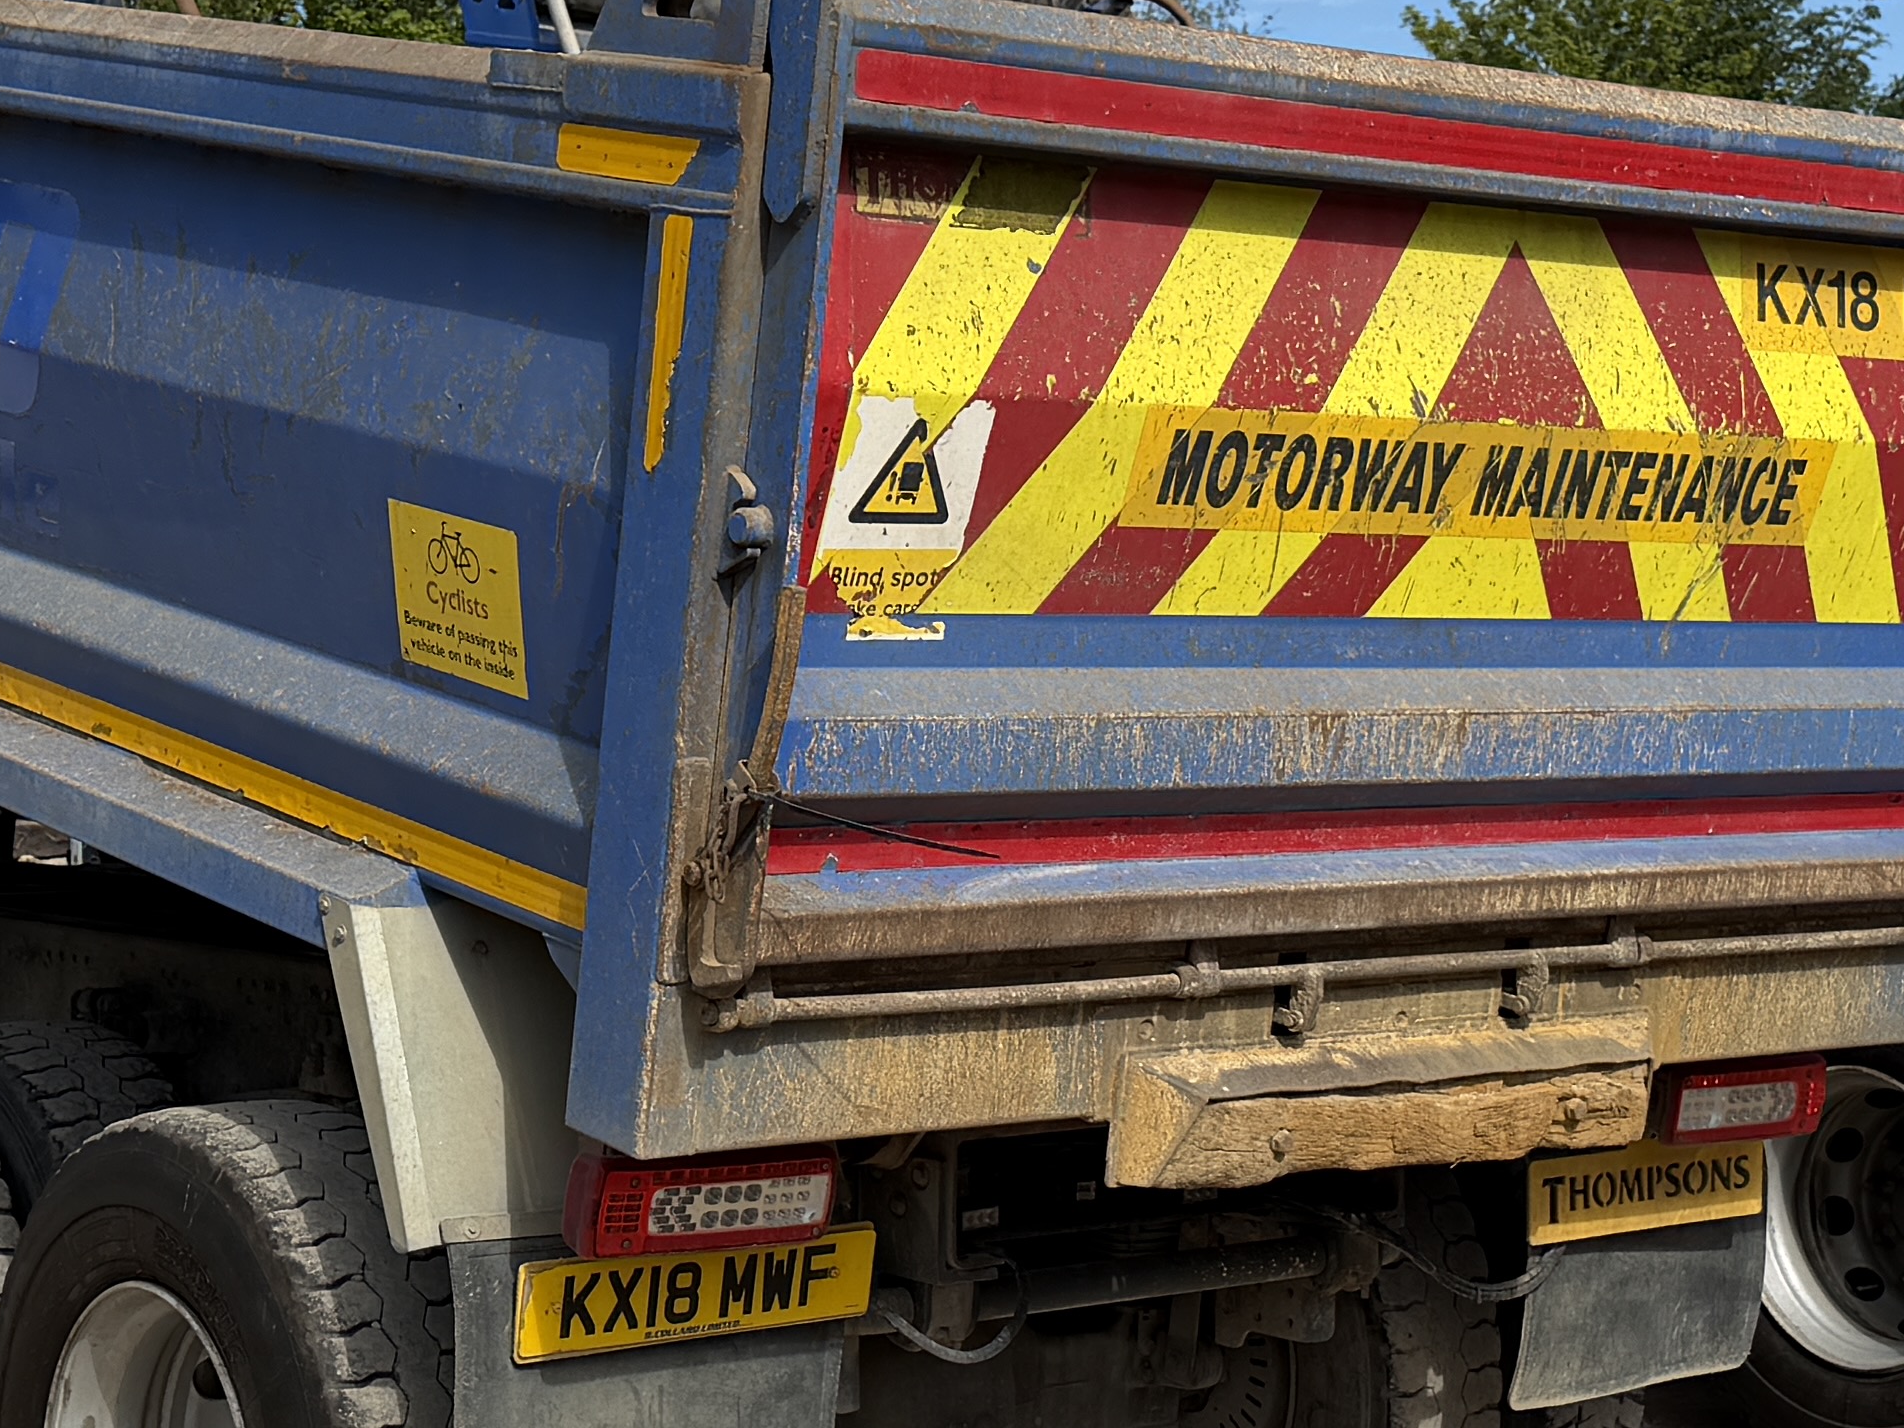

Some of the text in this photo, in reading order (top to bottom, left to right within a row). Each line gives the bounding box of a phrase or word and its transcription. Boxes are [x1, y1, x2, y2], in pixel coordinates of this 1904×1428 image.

[1753, 259, 1882, 333] KX18
[1156, 427, 1808, 528] MOTORWAY MAINTENANCE
[426, 581, 489, 620] Cyclists
[832, 567, 939, 592] Blind spot
[849, 601, 877, 616] ake
[403, 610, 518, 658] Beware of passing this
[411, 638, 515, 680] vehicle on the inside
[1542, 1155, 1751, 1225] THOMPSONS
[558, 1243, 837, 1340] KX18 MWF
